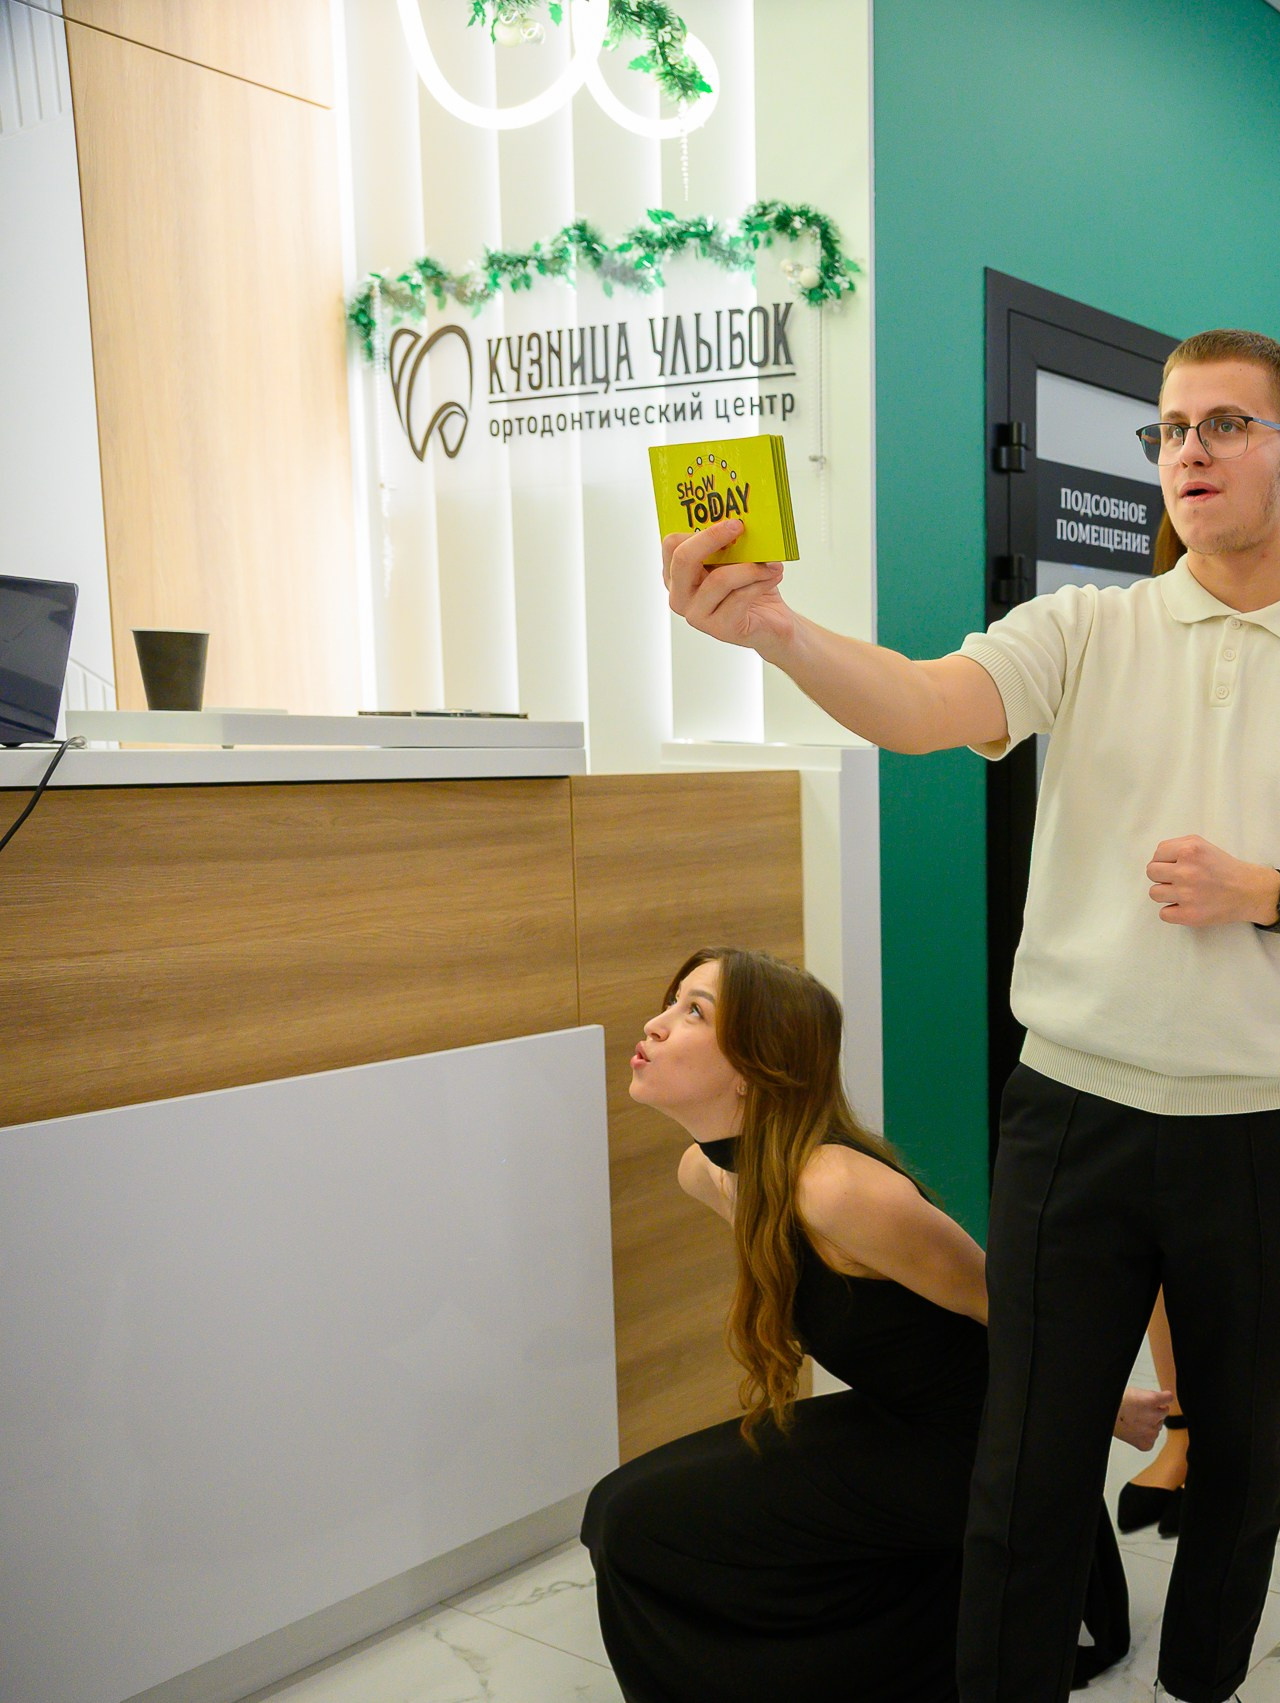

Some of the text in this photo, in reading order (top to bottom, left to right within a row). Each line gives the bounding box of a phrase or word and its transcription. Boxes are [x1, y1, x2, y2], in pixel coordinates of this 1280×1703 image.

[486, 302, 794, 395] КУЗНИЦА УЛЫБОК
[489, 391, 795, 443] ортодонтический центр
[676, 474, 716, 501] SHOW
[1060, 487, 1148, 526] ПОДСОБНОЕ
[1056, 517, 1151, 556] ПОМЕЩЕНИЕ
